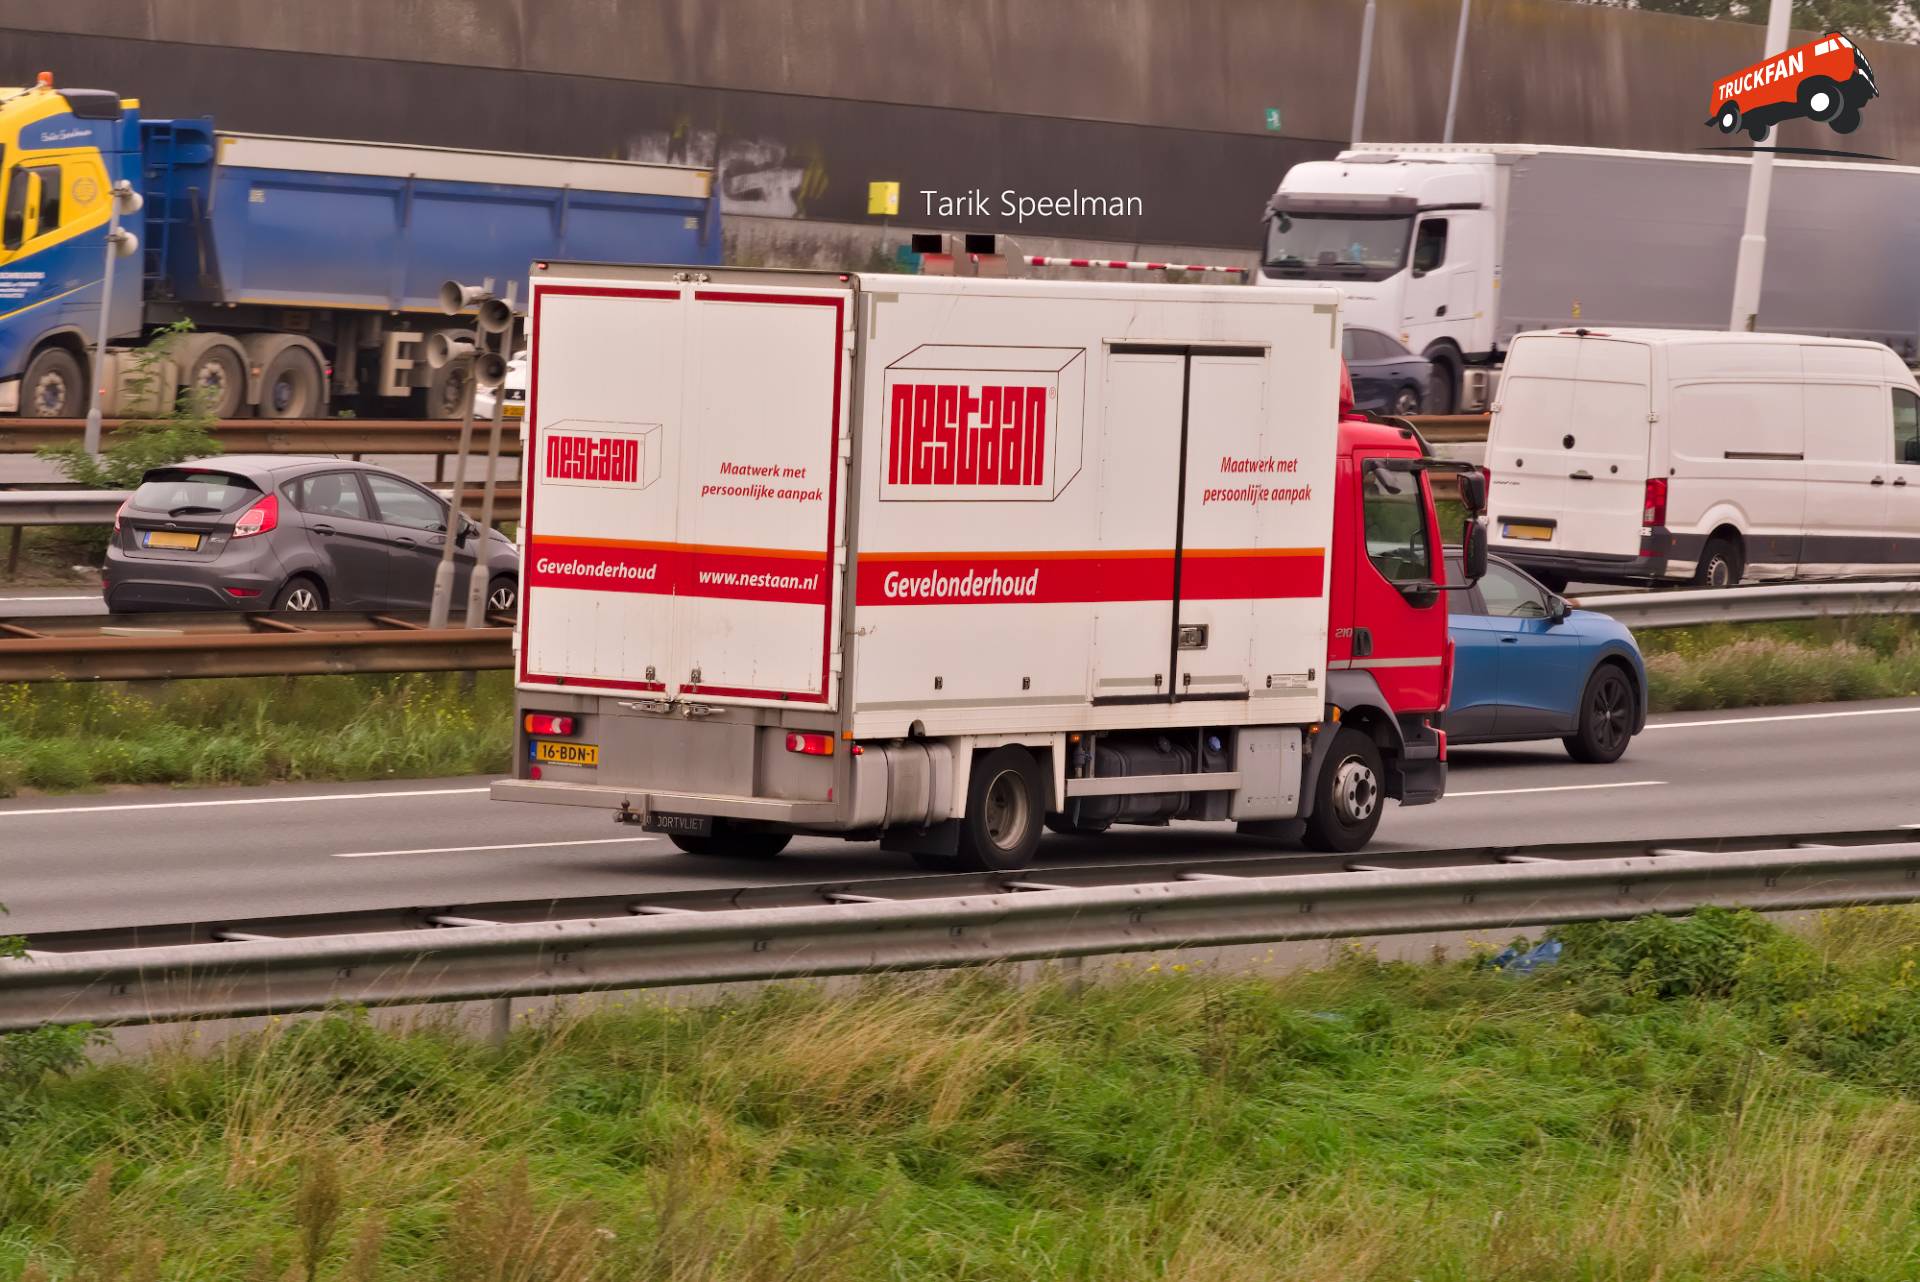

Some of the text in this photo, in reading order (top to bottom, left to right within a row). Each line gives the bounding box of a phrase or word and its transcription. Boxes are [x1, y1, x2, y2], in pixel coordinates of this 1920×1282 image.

[720, 462, 806, 479] Maatwerk met
[1220, 456, 1297, 473] Maatwerk met
[701, 483, 823, 502] persoonlijke aanpak
[1203, 484, 1311, 505] persoonlijke aanpak
[537, 558, 657, 580] Gevelonderhoud
[699, 571, 819, 590] www.nestaan.nl
[884, 568, 1039, 598] Gevelonderhoud
[543, 744, 595, 762] 16-BDN-1
